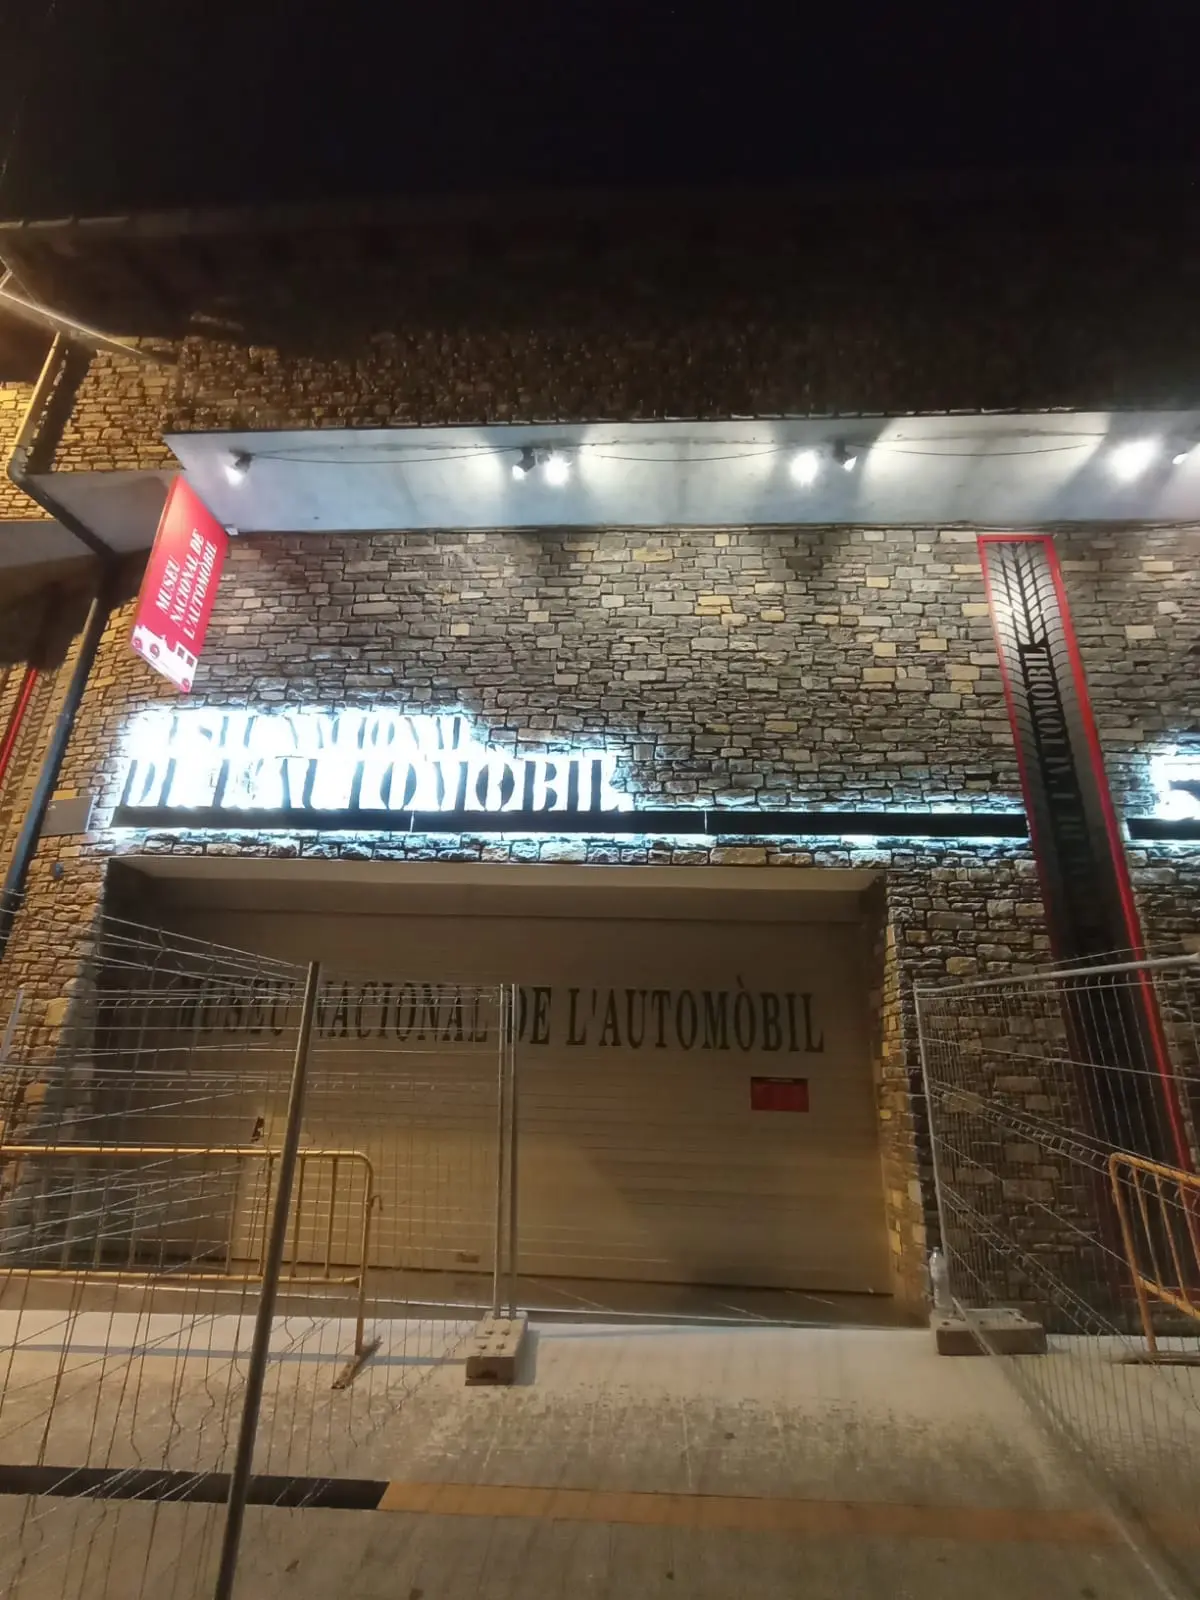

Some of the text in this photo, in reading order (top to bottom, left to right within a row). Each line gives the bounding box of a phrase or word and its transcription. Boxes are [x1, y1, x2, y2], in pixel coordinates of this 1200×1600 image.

[155, 554, 181, 614] MUSEU
[169, 528, 205, 627] NACIONAL DE
[183, 540, 218, 640] L'AUTOMÒBIL
[503, 985, 552, 1045] DE
[566, 973, 824, 1053] L'AUTOMÒBIL
